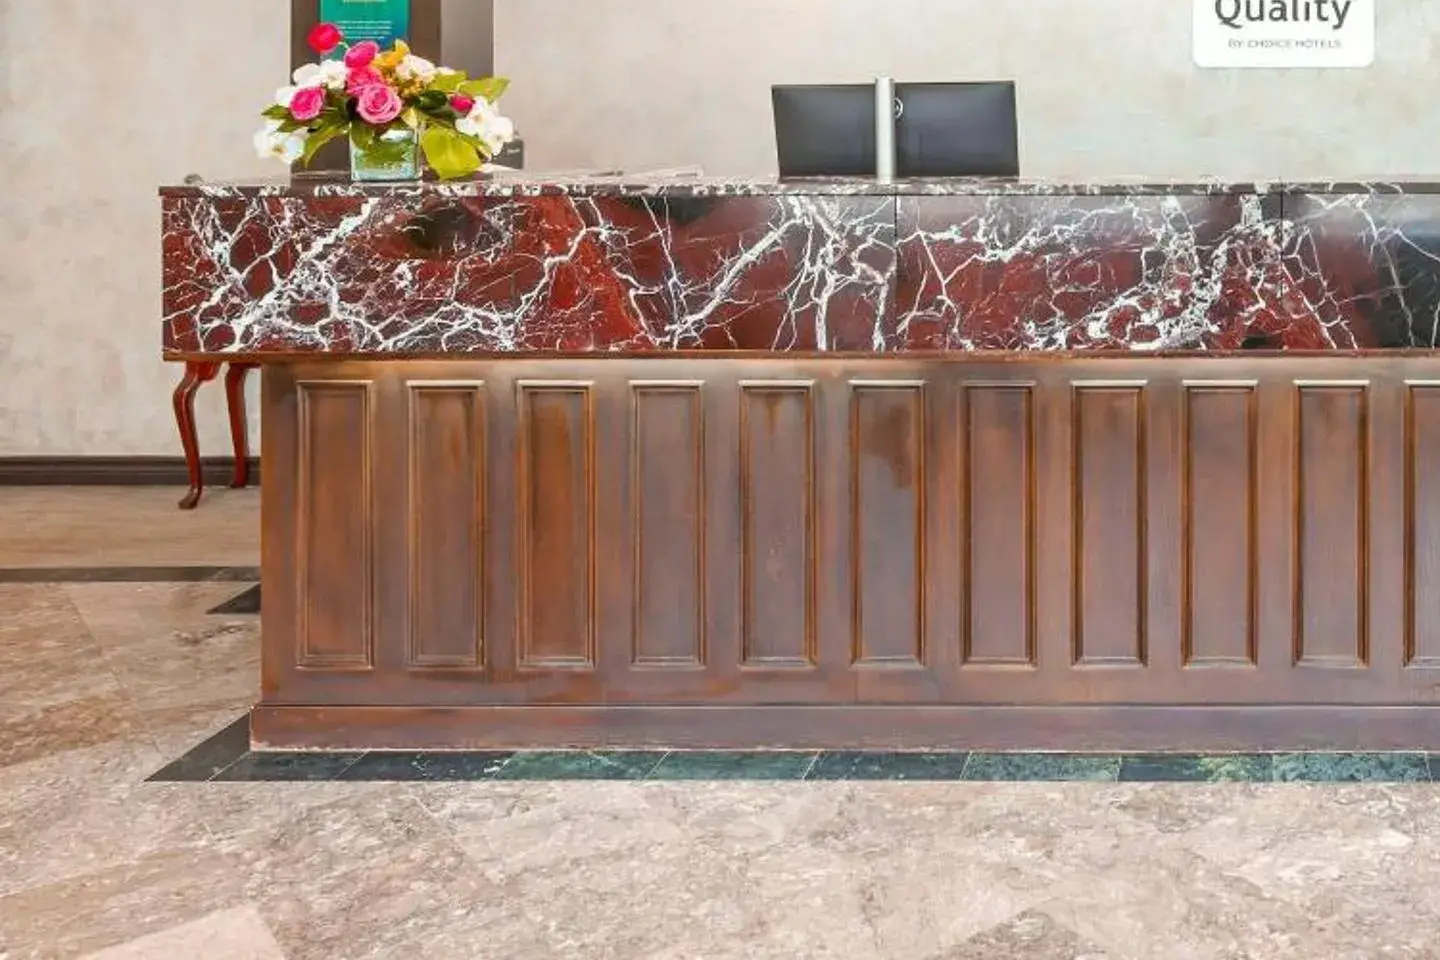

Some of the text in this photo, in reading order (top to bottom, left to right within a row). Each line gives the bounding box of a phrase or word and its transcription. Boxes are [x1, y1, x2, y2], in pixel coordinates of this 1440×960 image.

[1229, 39, 1341, 48] BY CHOICE HOTELS
